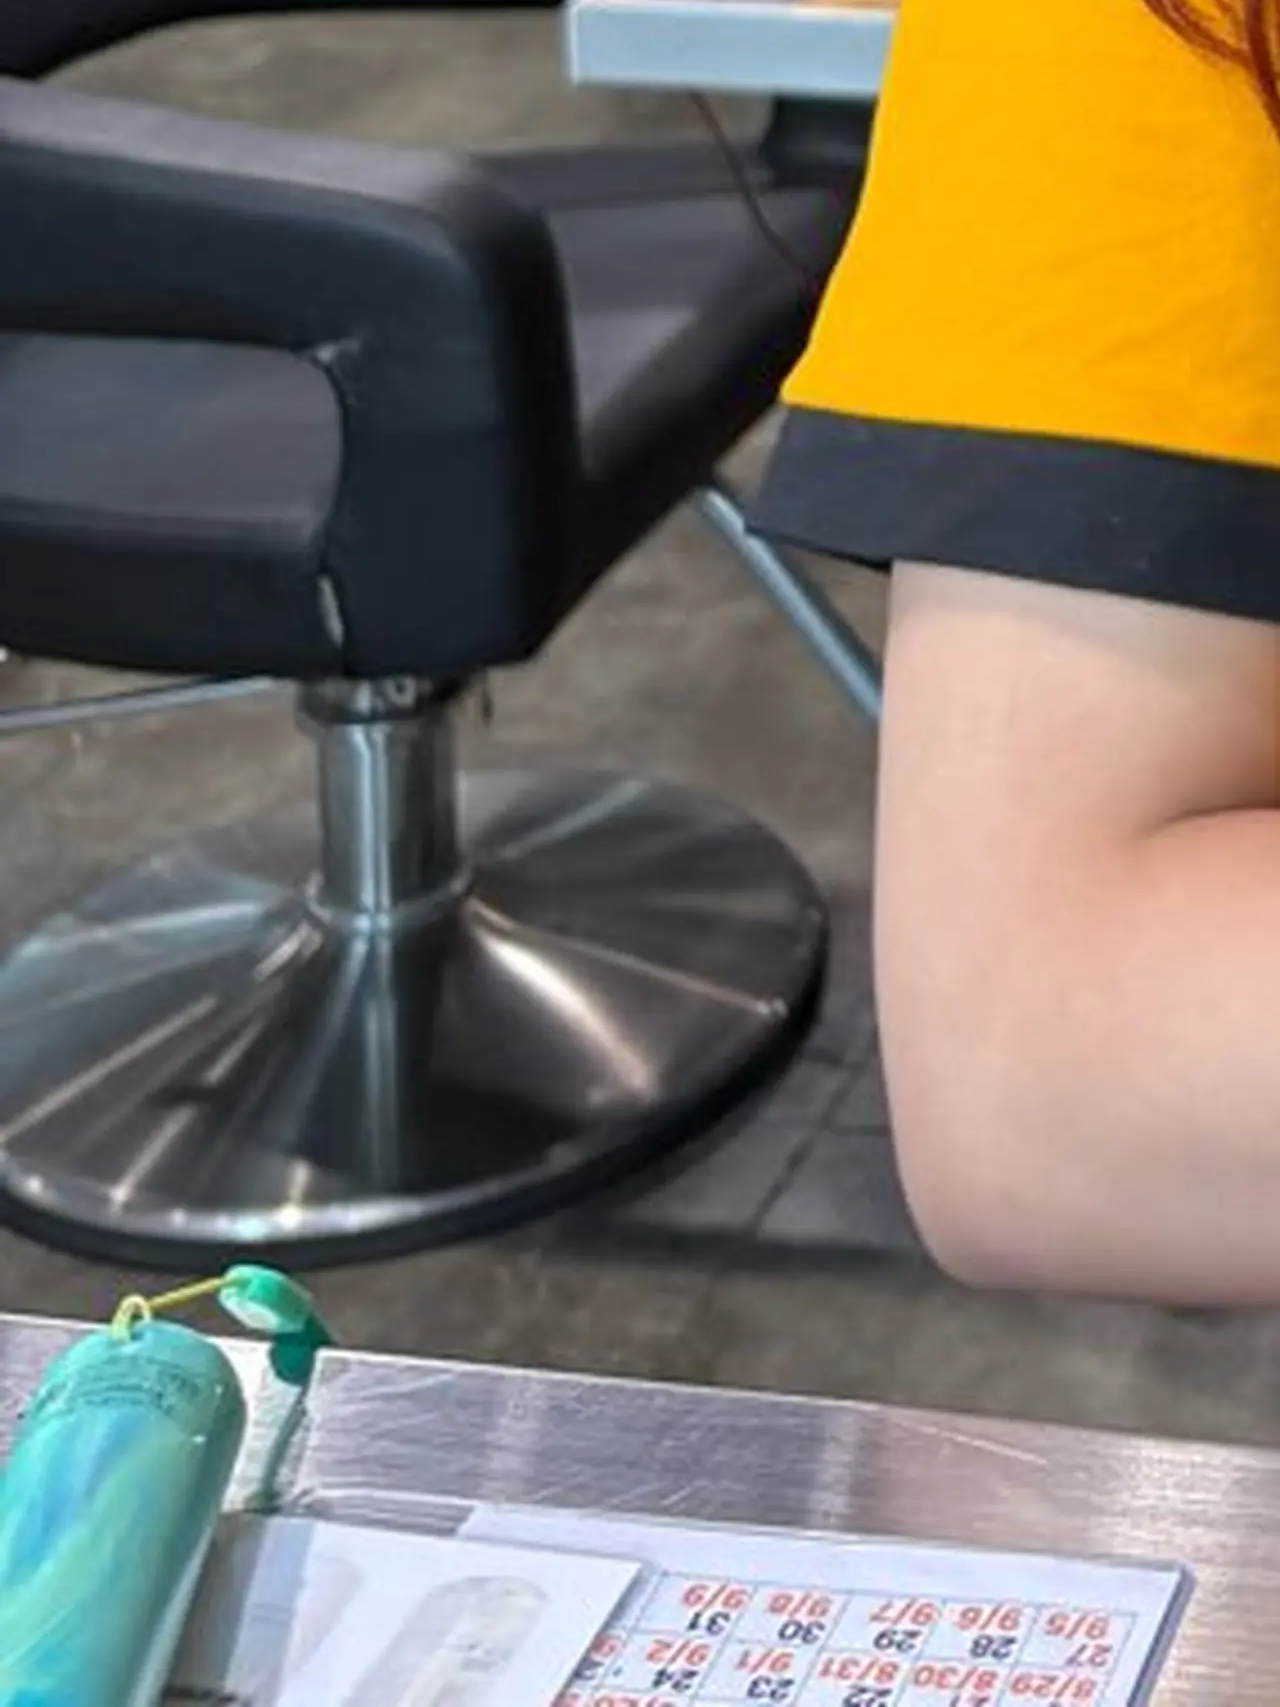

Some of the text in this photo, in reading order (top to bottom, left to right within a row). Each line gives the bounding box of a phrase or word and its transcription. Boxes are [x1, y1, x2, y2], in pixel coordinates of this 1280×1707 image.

[682, 1584, 748, 1610] 9/9
[869, 1598, 935, 1625] 9/7
[953, 1604, 1023, 1631] 9/6
[1043, 1611, 1110, 1639] 9/5
[646, 1639, 711, 1665] 9/2
[687, 1611, 1113, 1667] 27 28 29 30 31
[735, 1647, 794, 1673] 9/1
[819, 1654, 899, 1684] 8/31
[652, 1668, 699, 1692] 24
[747, 1676, 795, 1701] 23
[913, 1664, 998, 1691] 8/30
[1011, 1672, 1098, 1700] 8/29
